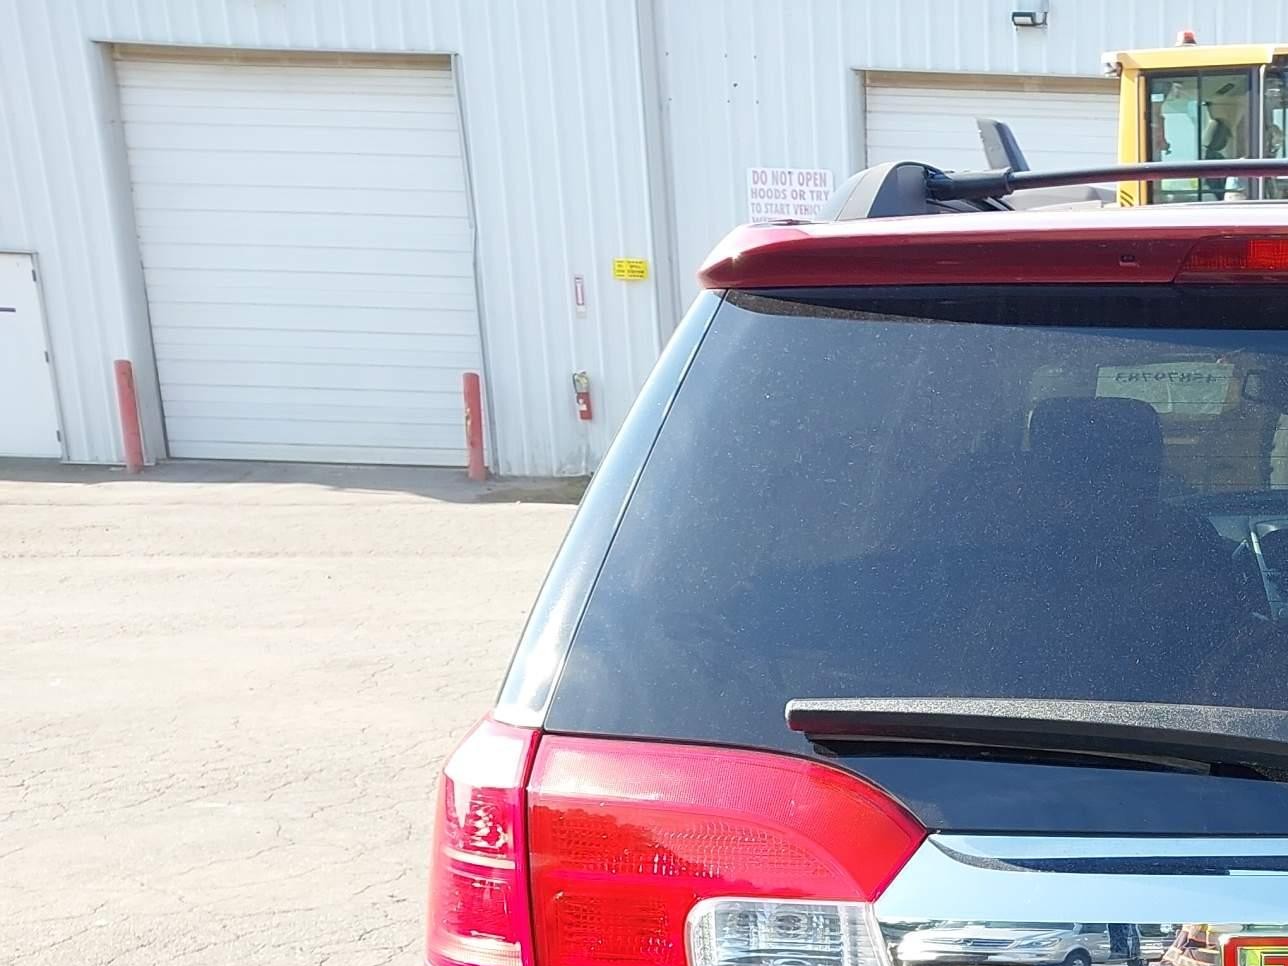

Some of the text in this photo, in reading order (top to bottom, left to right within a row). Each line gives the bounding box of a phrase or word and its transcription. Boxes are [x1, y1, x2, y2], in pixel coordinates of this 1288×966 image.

[752, 170, 827, 187] DO NOT OPEN
[751, 188, 830, 201] HOODS OR TRY
[751, 202, 762, 214] TO
[764, 203, 790, 215] START
